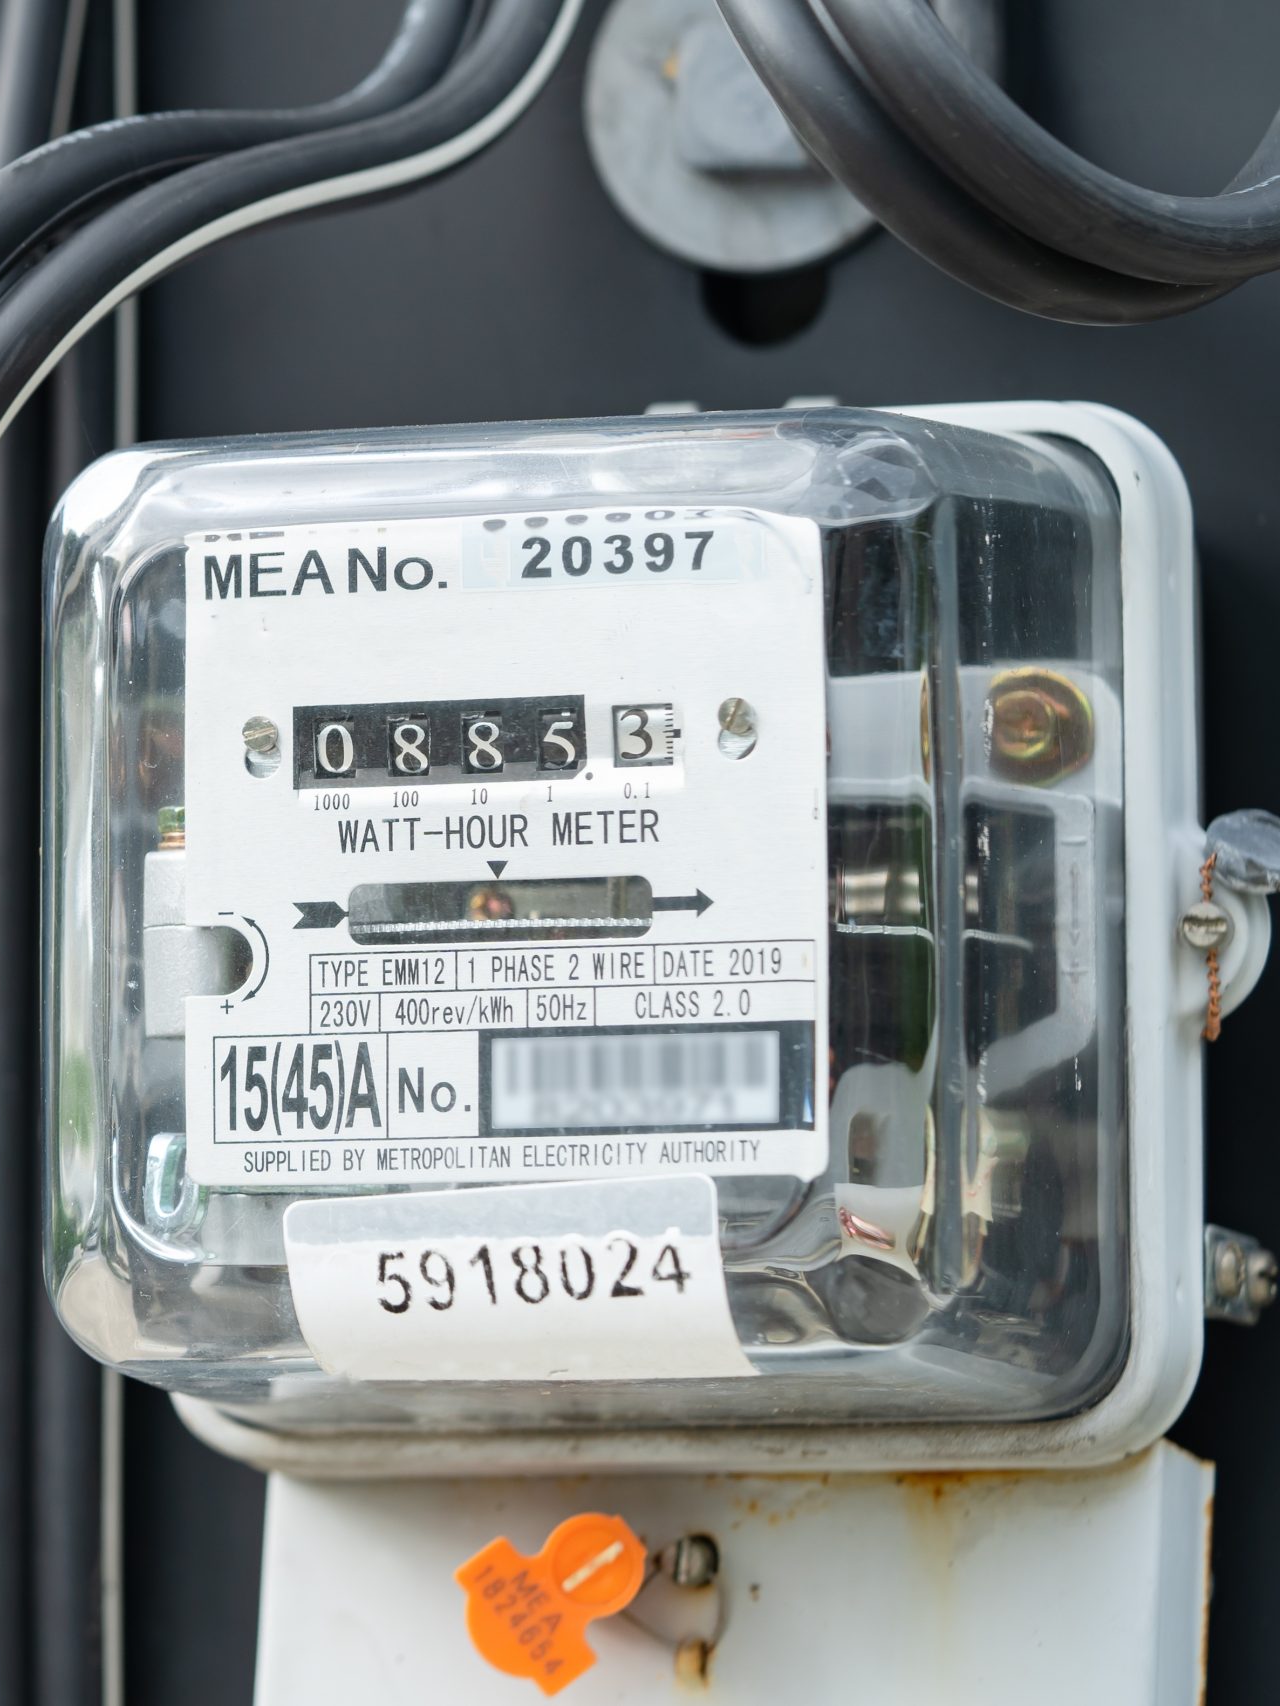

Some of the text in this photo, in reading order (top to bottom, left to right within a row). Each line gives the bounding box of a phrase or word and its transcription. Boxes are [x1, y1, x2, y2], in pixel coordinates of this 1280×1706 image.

[521, 530, 714, 579] 20397
[313, 782, 651, 811] 1000 100 10 1 0.1
[337, 808, 660, 854] WATT-HOUR METER
[317, 957, 445, 988] TYPE EMM12
[467, 951, 645, 984] 1 PHASE 2 WIRE
[662, 947, 782, 978] DATE 2019
[319, 999, 371, 1028] 230V
[394, 995, 513, 1026] 400rev/kWh
[536, 993, 587, 1022] 50Hz
[634, 990, 700, 1020] CLASS
[220, 1039, 382, 1136] 15(45)A
[398, 1066, 471, 1114] No.
[243, 1139, 760, 1173] SUPPLIED BY METROPOLITAN ELECTRICITY AUTHORITY
[375, 1237, 691, 1314] 5918024
[511, 1570, 562, 1634] MEA
